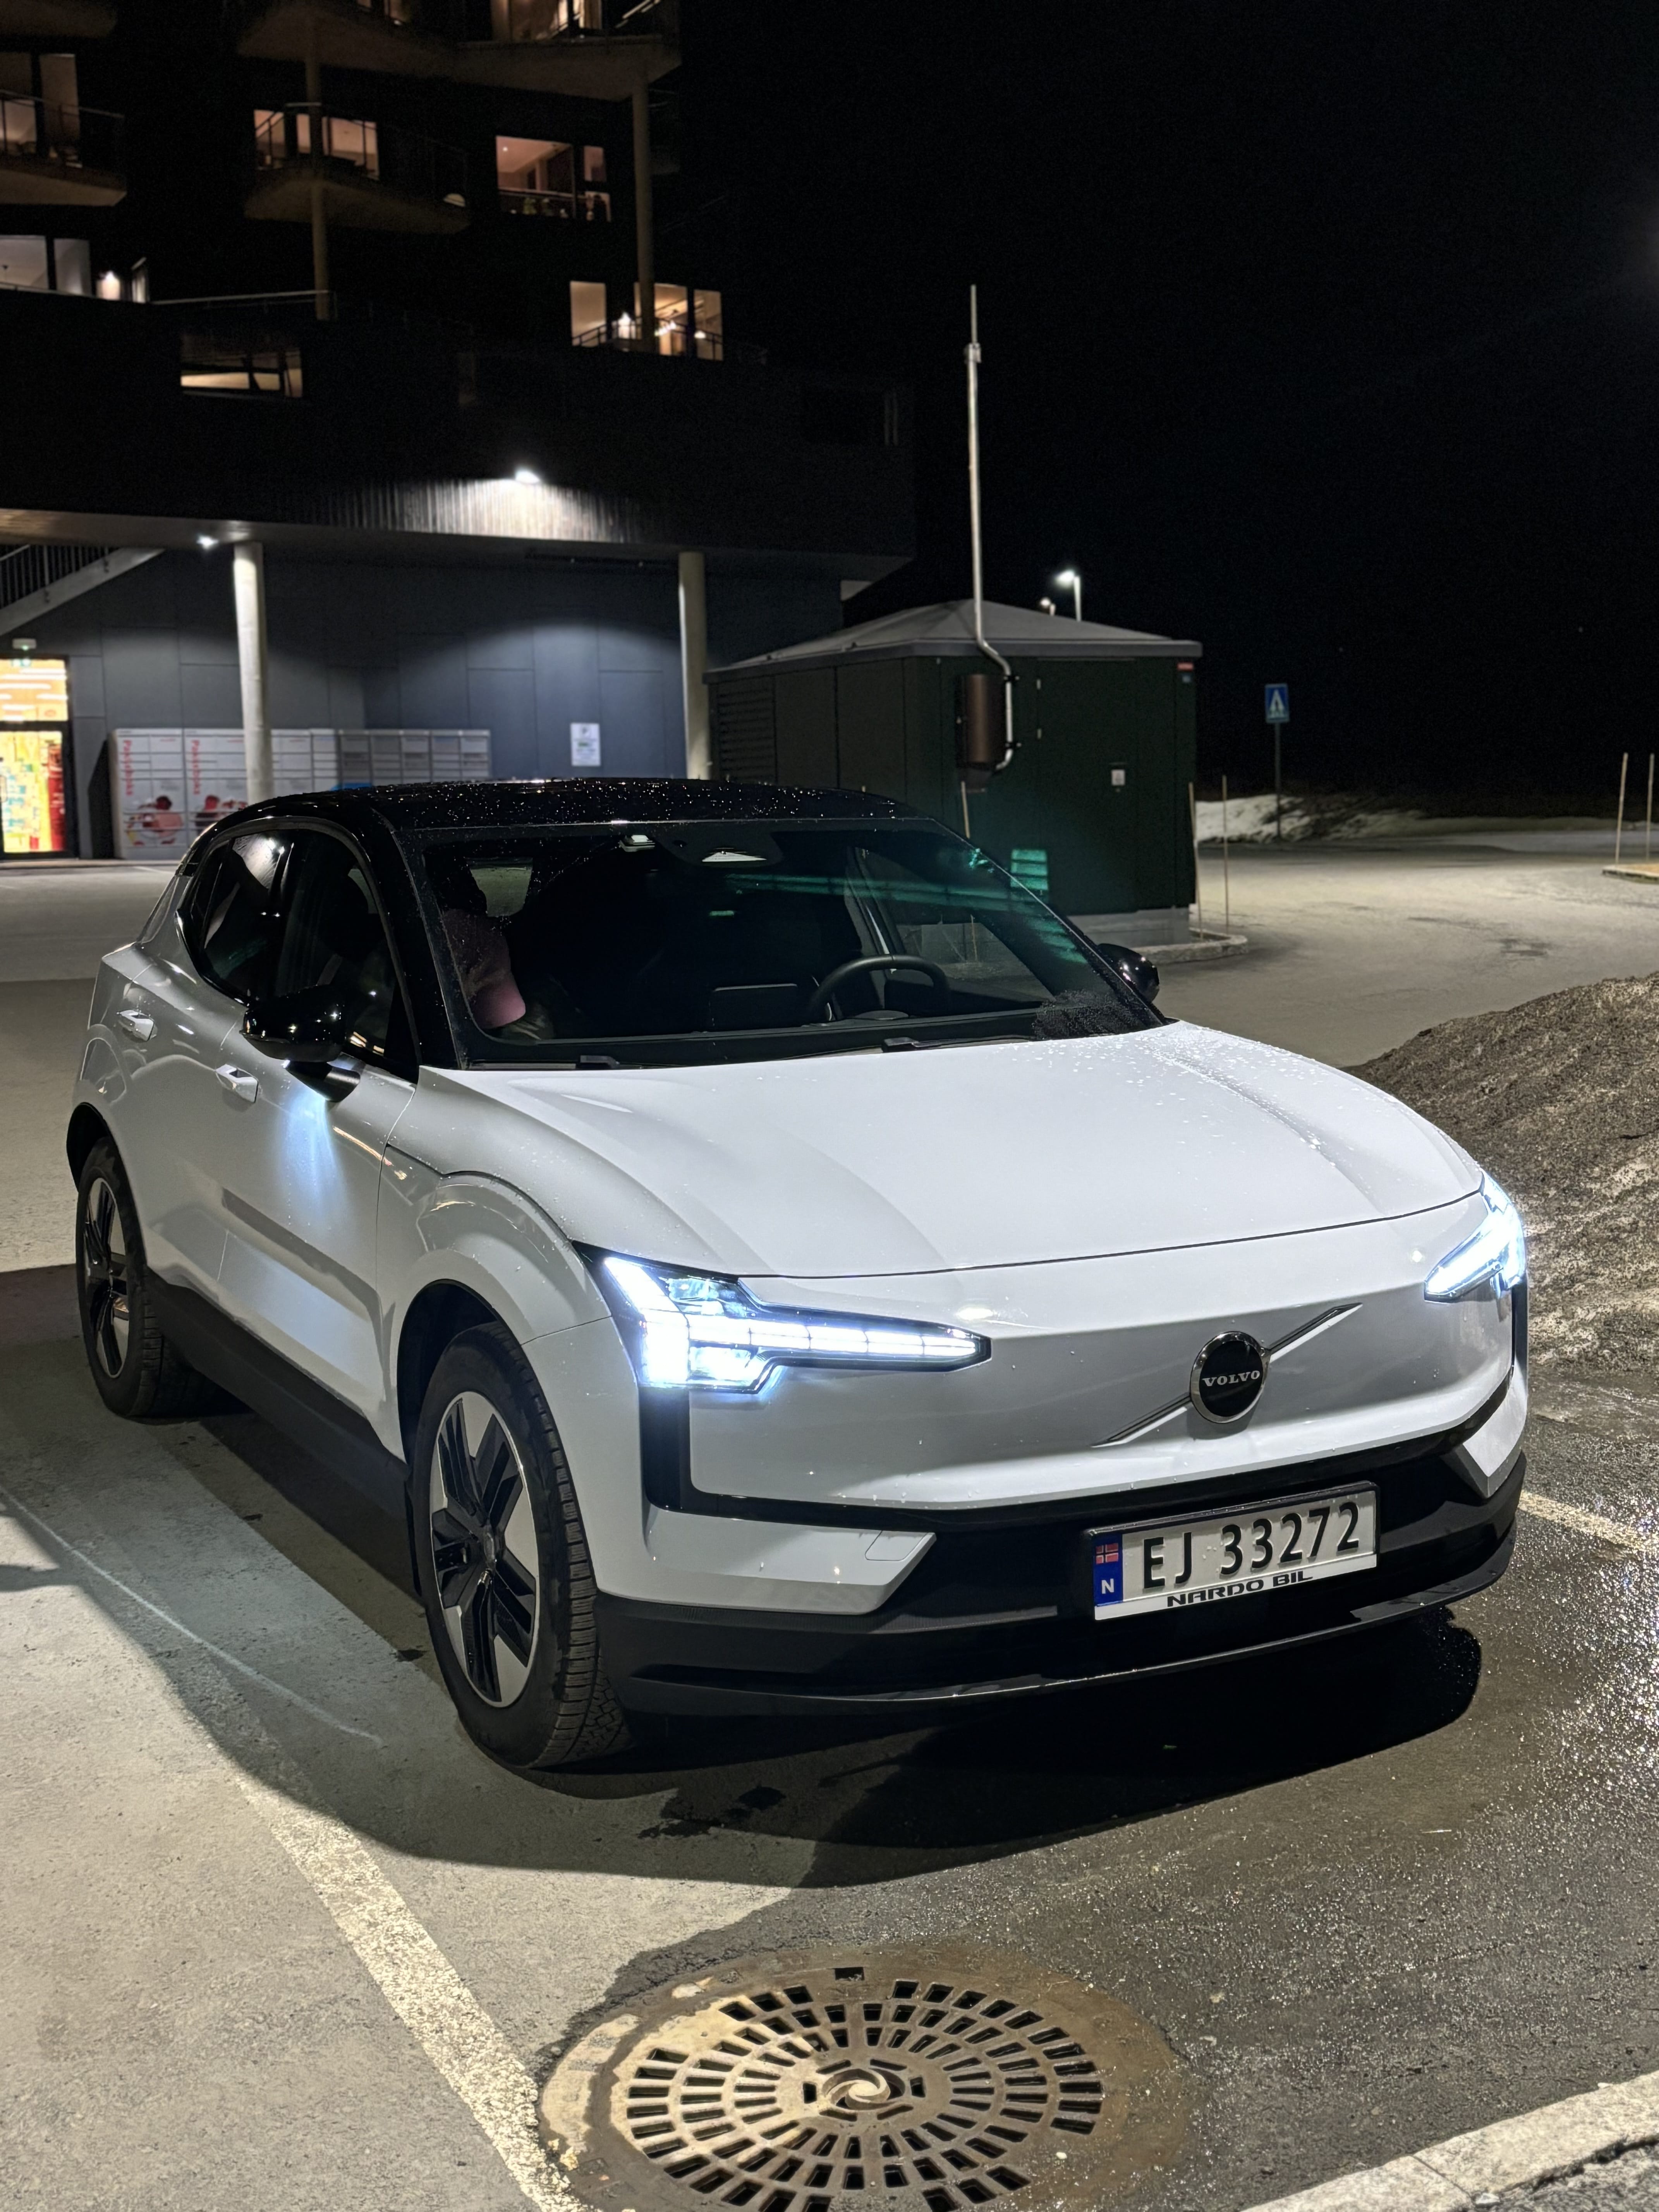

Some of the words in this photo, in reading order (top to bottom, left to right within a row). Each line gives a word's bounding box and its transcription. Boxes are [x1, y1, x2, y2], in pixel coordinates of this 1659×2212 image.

[1202, 1370, 1260, 1386] VOLVO
[1144, 1532, 1192, 1589] EJ
[1220, 1502, 1359, 1575] 33272
[1101, 1578, 1115, 1594] N
[1167, 1579, 1264, 1607] NARDO
[1273, 1571, 1313, 1587] BIL
